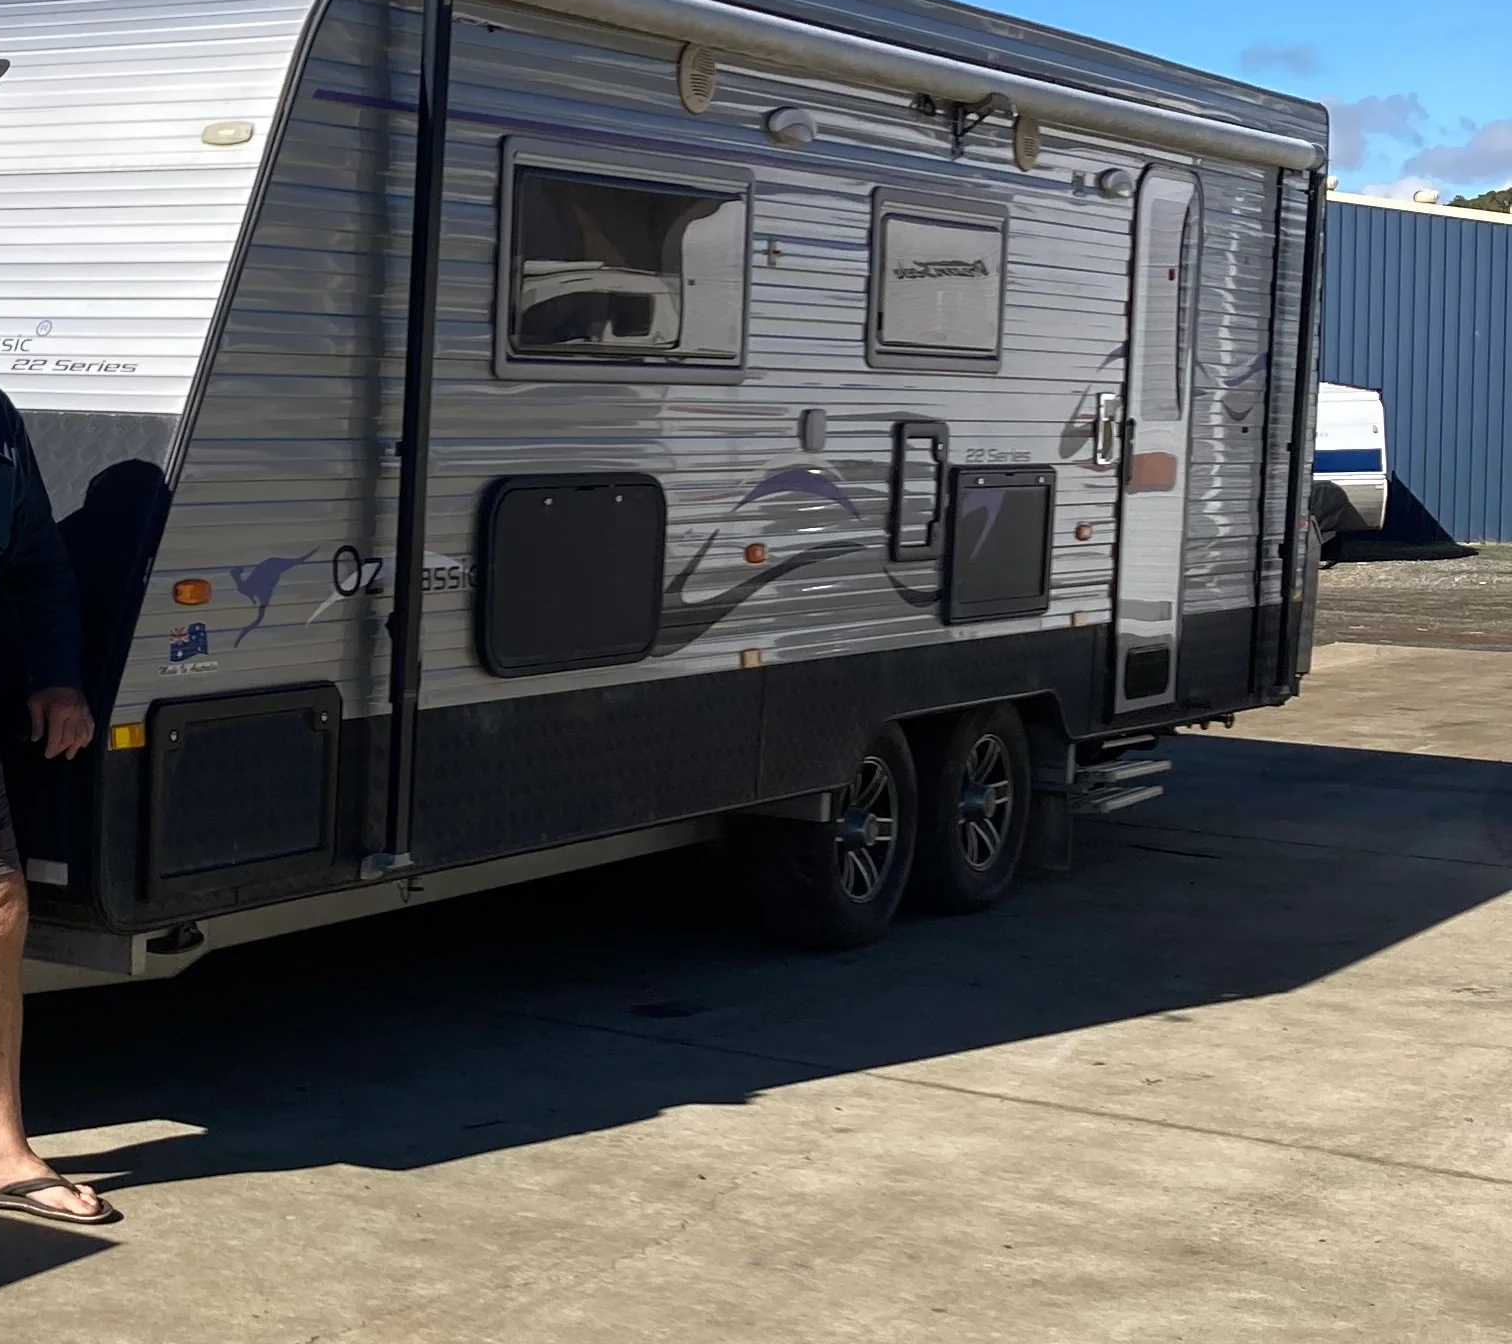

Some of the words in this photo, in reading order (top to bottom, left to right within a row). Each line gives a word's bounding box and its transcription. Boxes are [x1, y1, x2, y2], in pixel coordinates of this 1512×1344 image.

[11, 358, 48, 371] 22
[51, 359, 138, 373] Series
[965, 448, 984, 463] 22
[987, 448, 1031, 463] Series
[420, 557, 480, 592] assic
